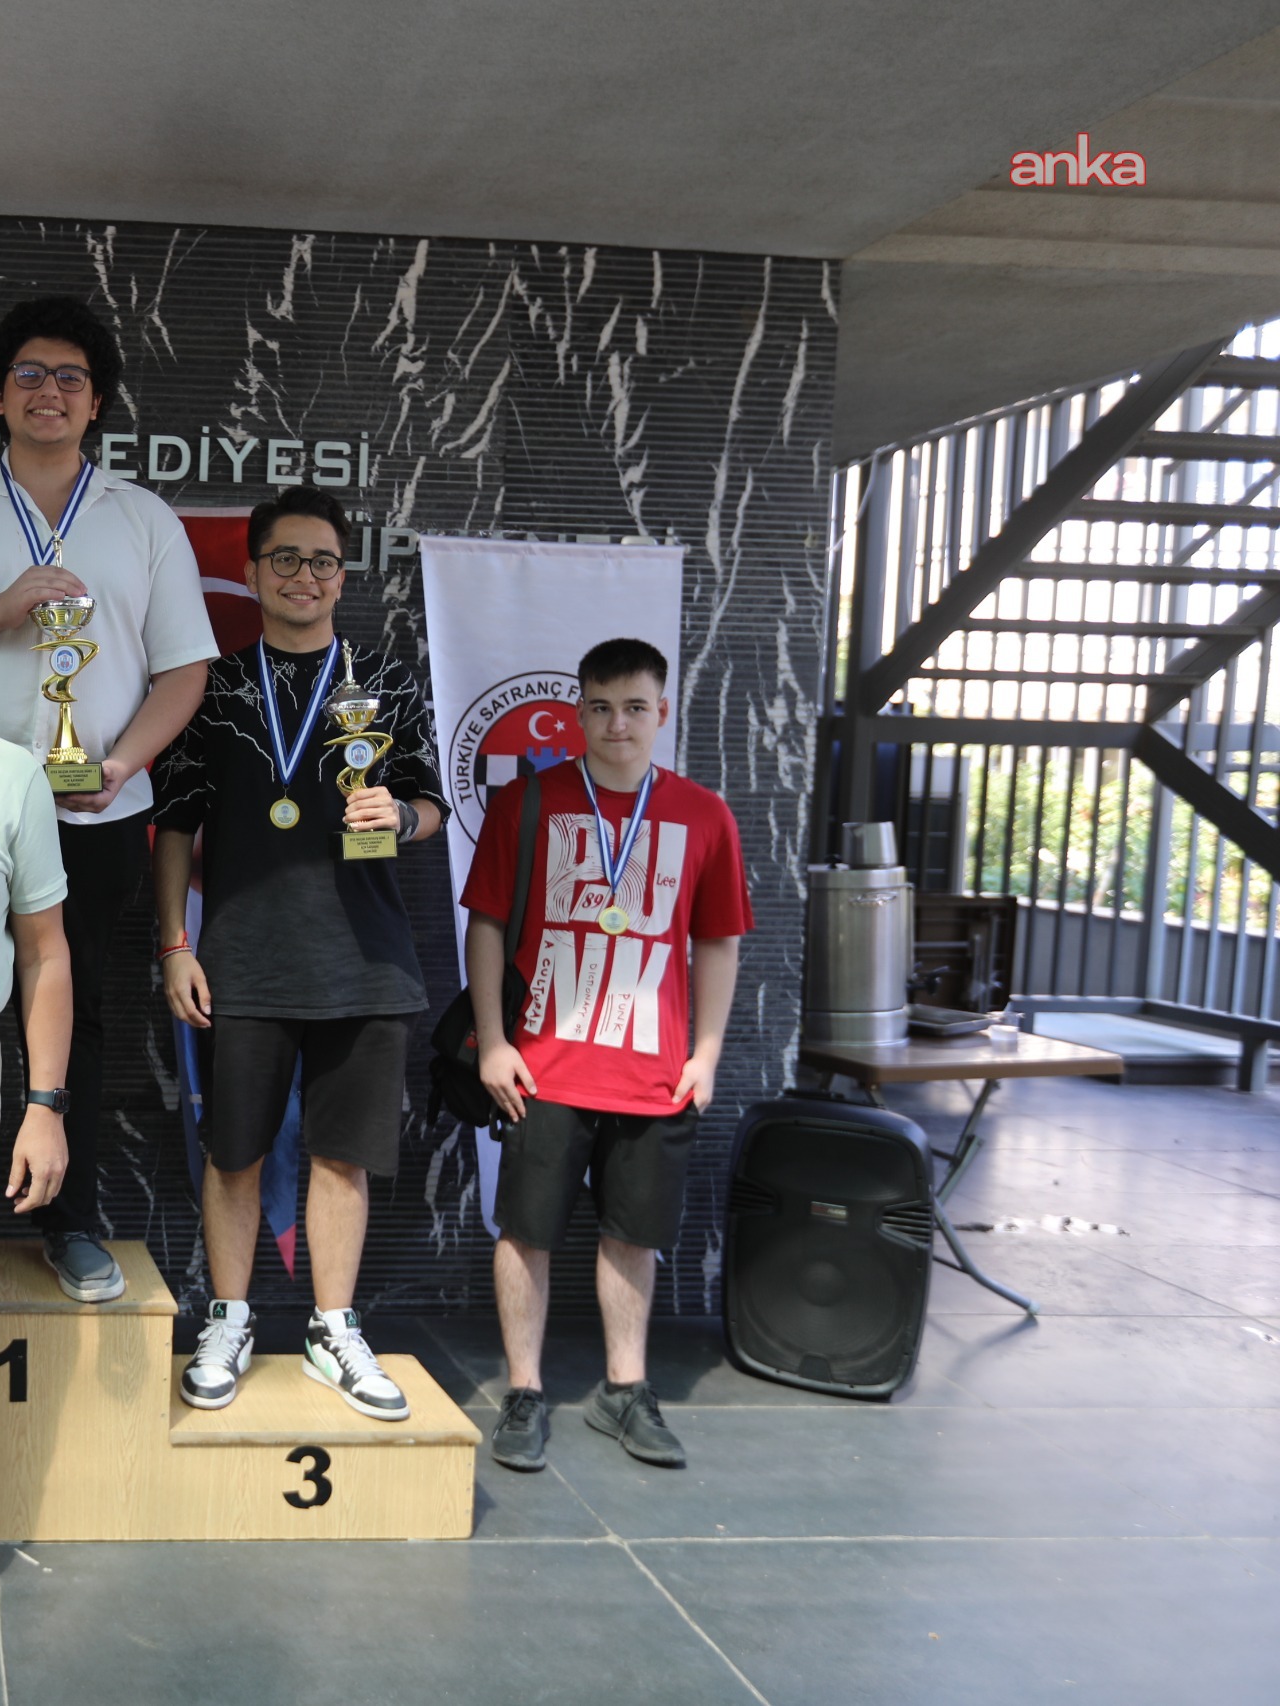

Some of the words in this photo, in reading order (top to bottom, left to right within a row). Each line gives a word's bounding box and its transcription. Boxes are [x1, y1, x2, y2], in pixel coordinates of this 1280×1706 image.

[455, 720, 484, 805] TÜRKİYE
[479, 681, 562, 722] SATRANÇ
[656, 873, 677, 888] Lee
[544, 940, 555, 949] A
[613, 993, 631, 1032] PUNK
[282, 1445, 332, 1509] 3
